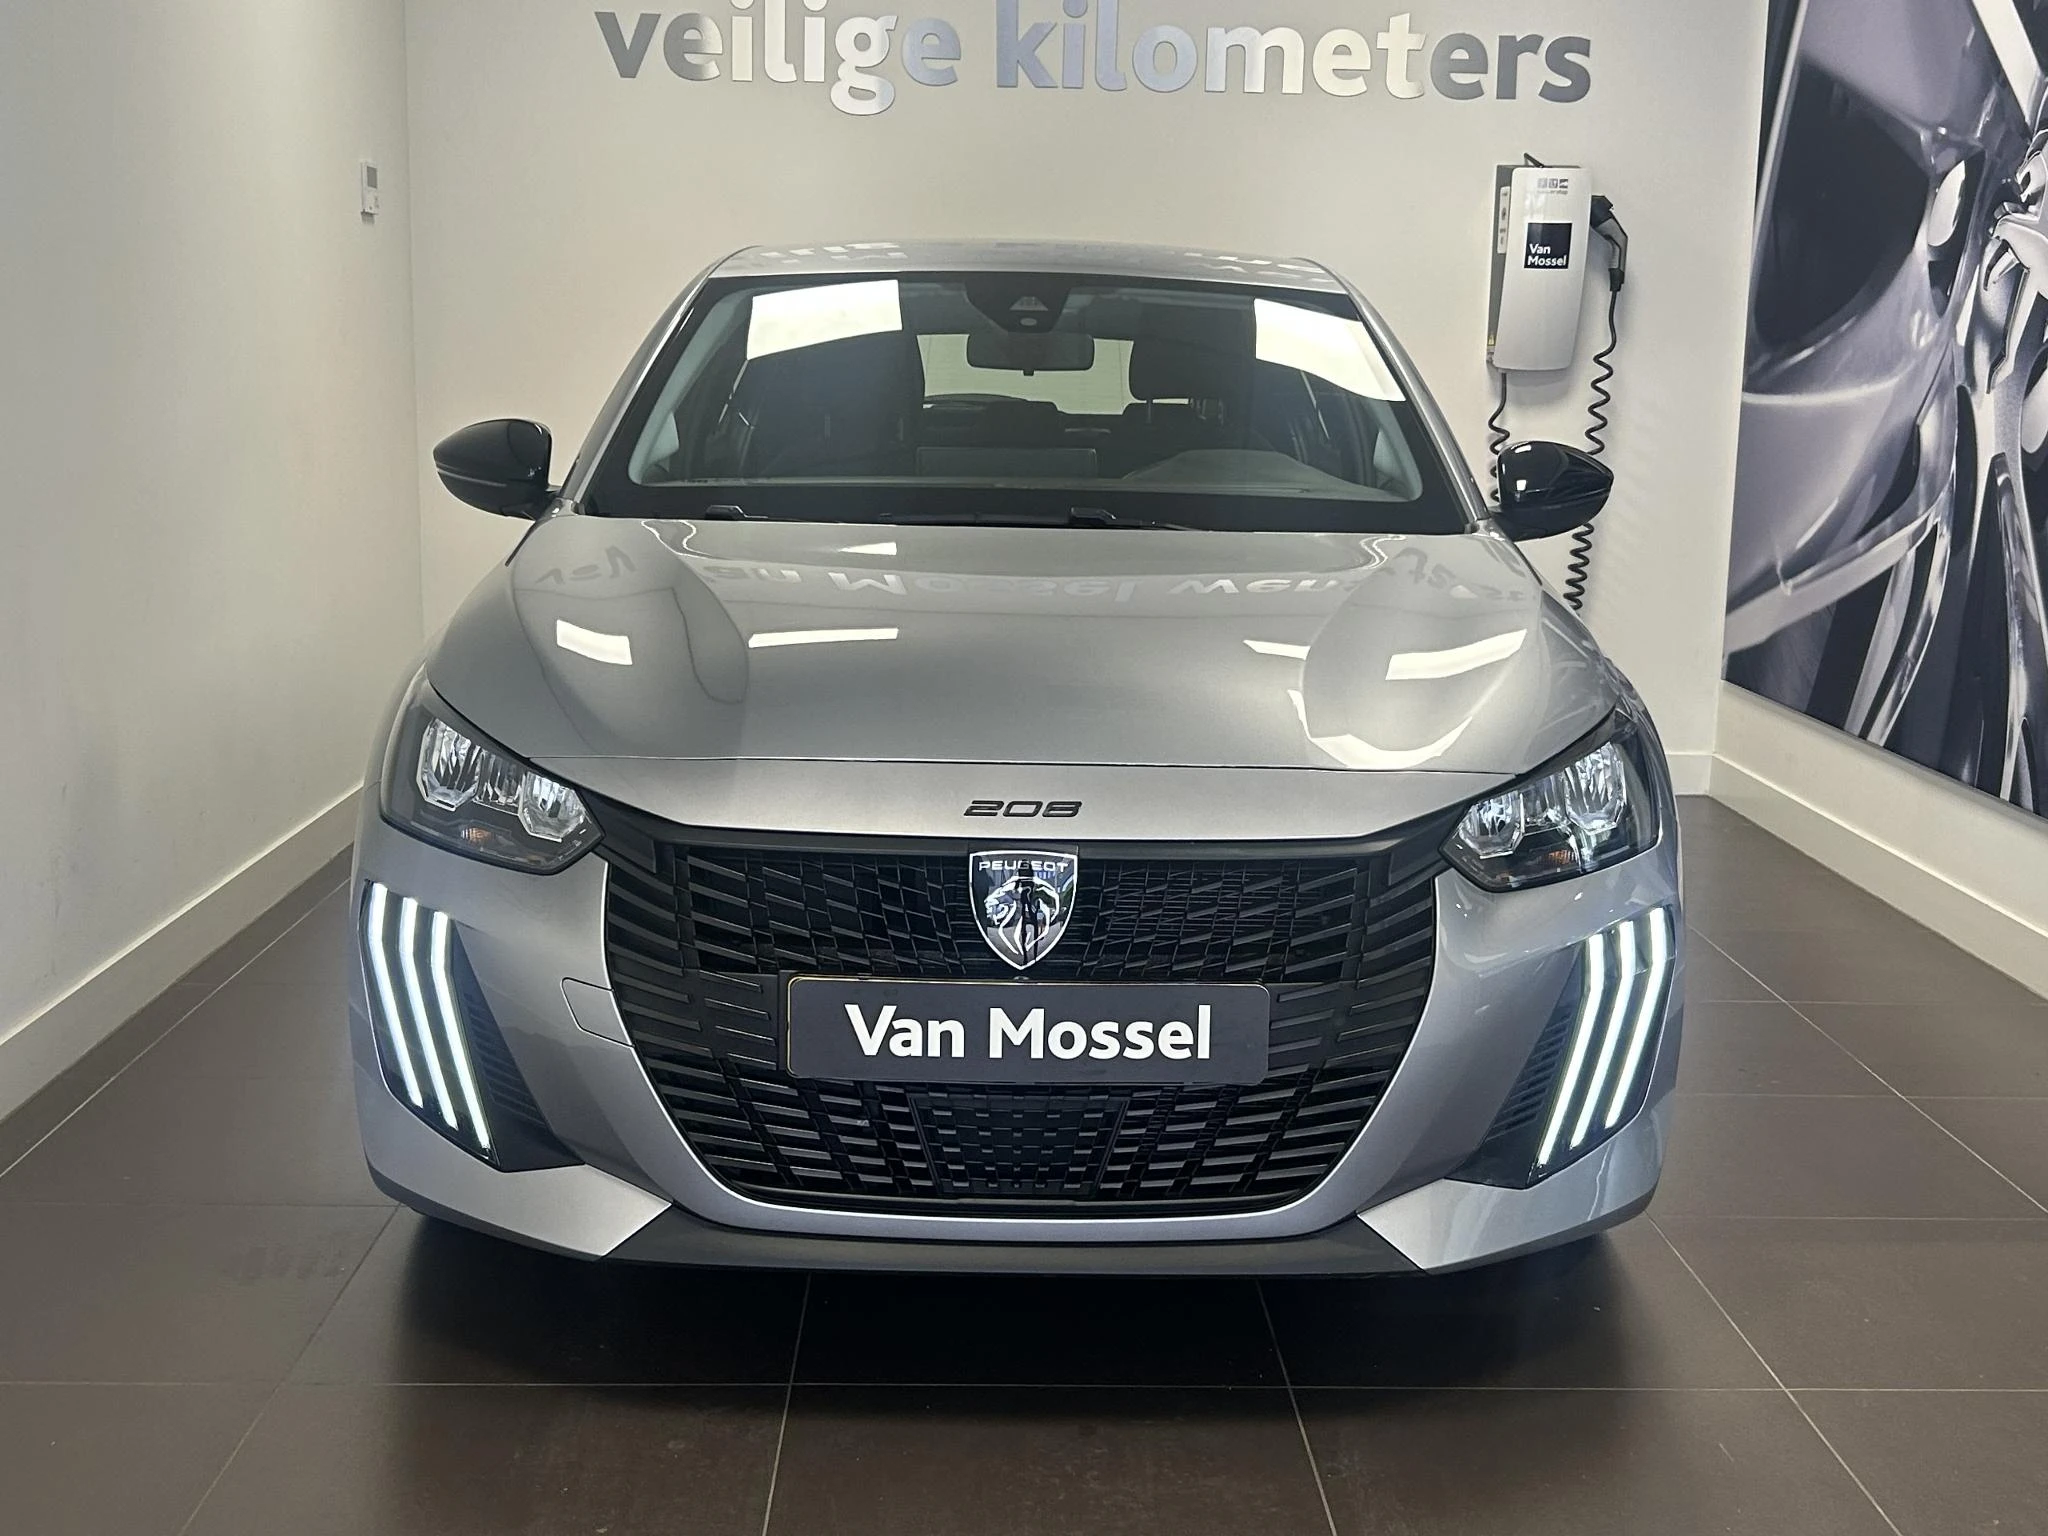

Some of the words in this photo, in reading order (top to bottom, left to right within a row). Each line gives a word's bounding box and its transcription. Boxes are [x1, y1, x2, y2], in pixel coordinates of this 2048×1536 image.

[594, 0, 962, 116] veilige
[996, 0, 1592, 103] kilometers
[1529, 243, 1551, 254] Van
[1527, 255, 1567, 266] Mossel
[963, 800, 1082, 818] 208
[978, 860, 1069, 873] PEUGEOT
[845, 1003, 965, 1058] Van
[989, 1004, 1211, 1060] Mossel
